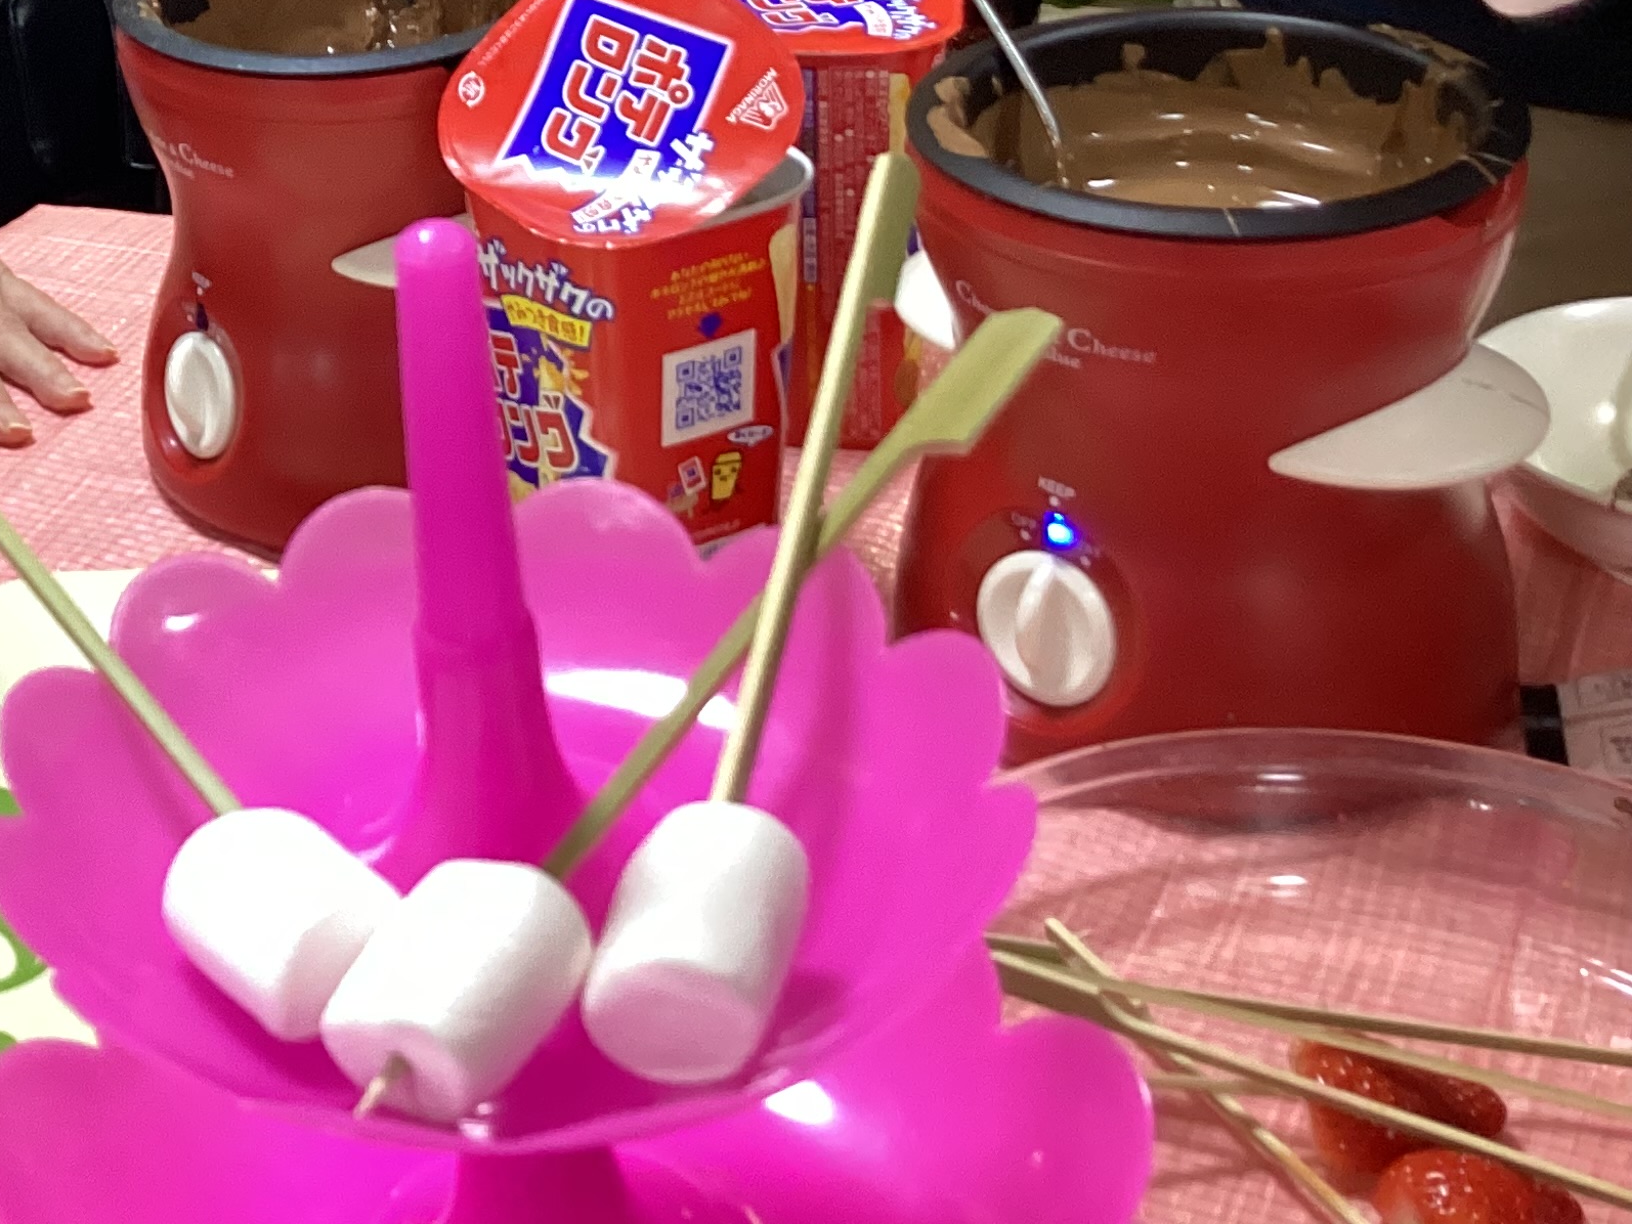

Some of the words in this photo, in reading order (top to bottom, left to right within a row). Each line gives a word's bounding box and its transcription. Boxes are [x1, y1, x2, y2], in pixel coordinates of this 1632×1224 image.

[540, 13, 640, 175] ロング
[628, 34, 695, 147] ポテ
[725, 66, 779, 124] MORINAGA
[1067, 327, 1157, 364] Cheese
